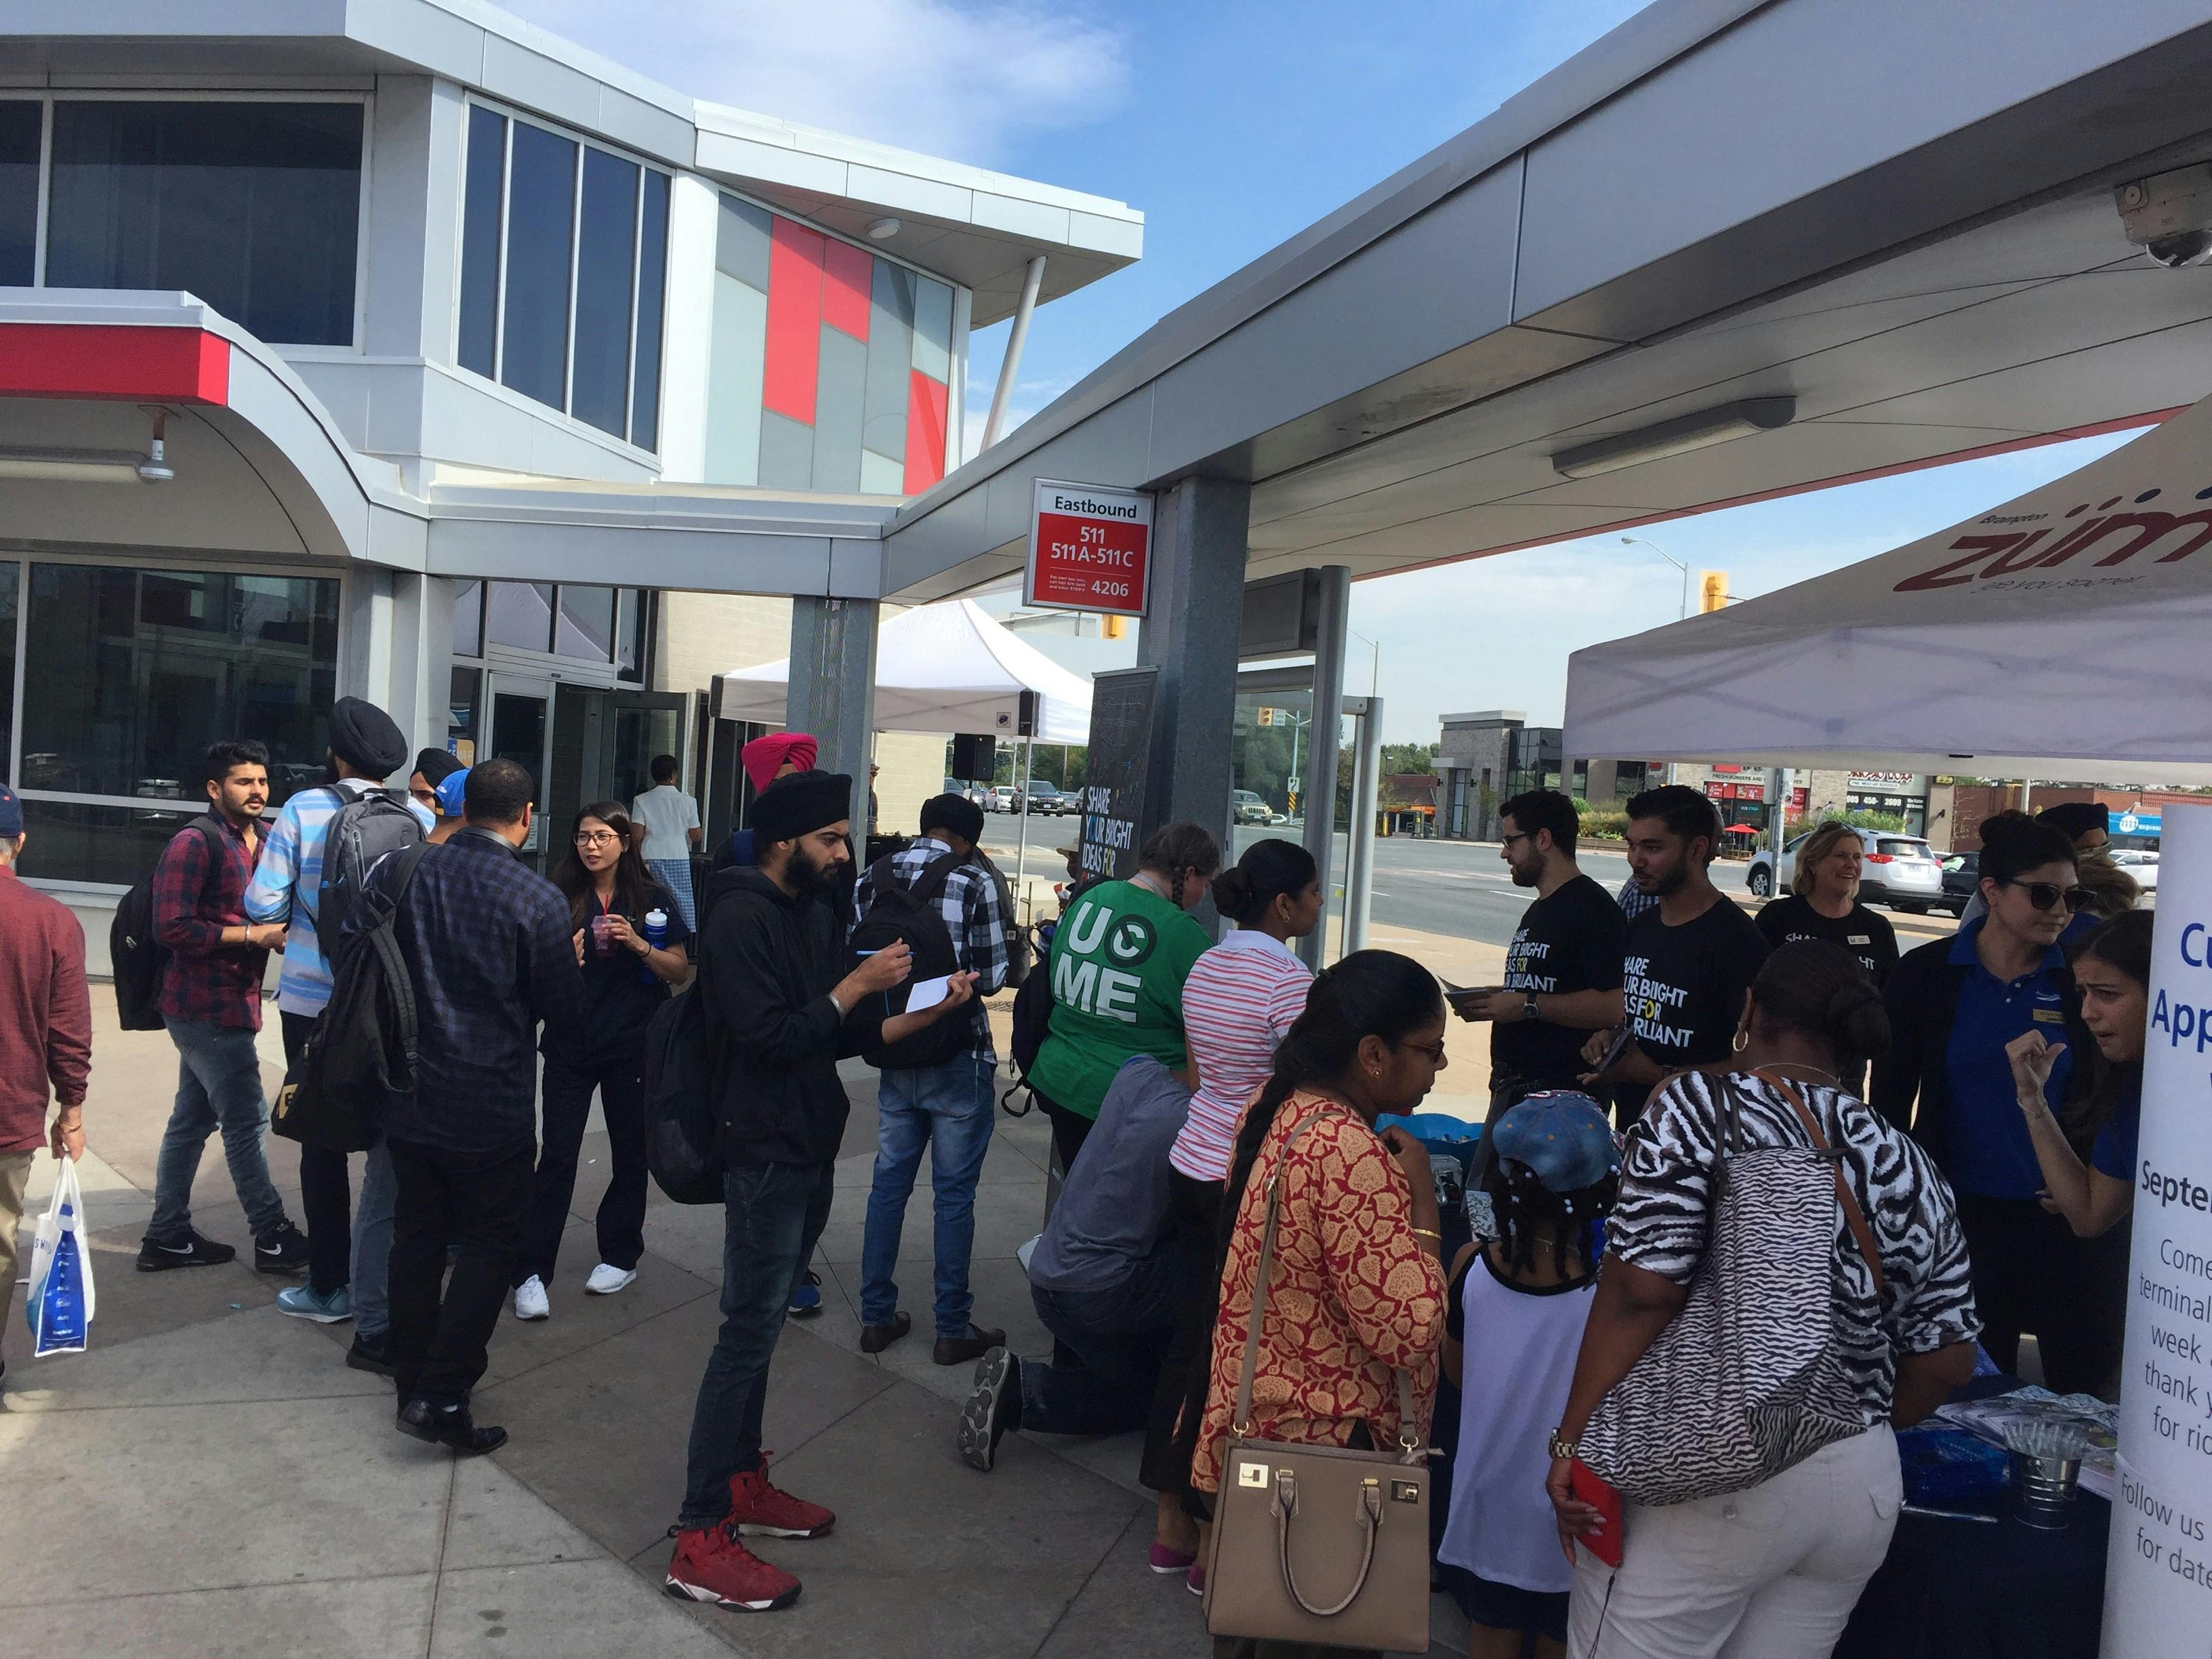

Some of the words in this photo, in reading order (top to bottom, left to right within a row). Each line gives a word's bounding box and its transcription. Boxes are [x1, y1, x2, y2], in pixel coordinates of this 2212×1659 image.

[1055, 496, 1136, 518] Eastbound
[1080, 527, 1105, 544] 511
[1051, 543, 1133, 567] 511A-511C
[1091, 580, 1128, 596] 4206
[1087, 786, 1111, 815] SHARE
[1086, 815, 1105, 843] YOUR
[1105, 818, 1133, 851] BRIGHT
[1082, 842, 1102, 874] IDEAS
[1103, 847, 1115, 878] FOR
[1054, 952, 1142, 1023] ME
[2142, 1160, 2212, 1213] Septe
[2140, 1272, 2211, 1323] terminal
[2152, 1325, 2201, 1364] week
[2145, 1360, 2198, 1406] thank
[2154, 1405, 2179, 1441] for
[2121, 1473, 2173, 1525] Follow
[2180, 1514, 2204, 1541] us
[2137, 1526, 2163, 1563] for
